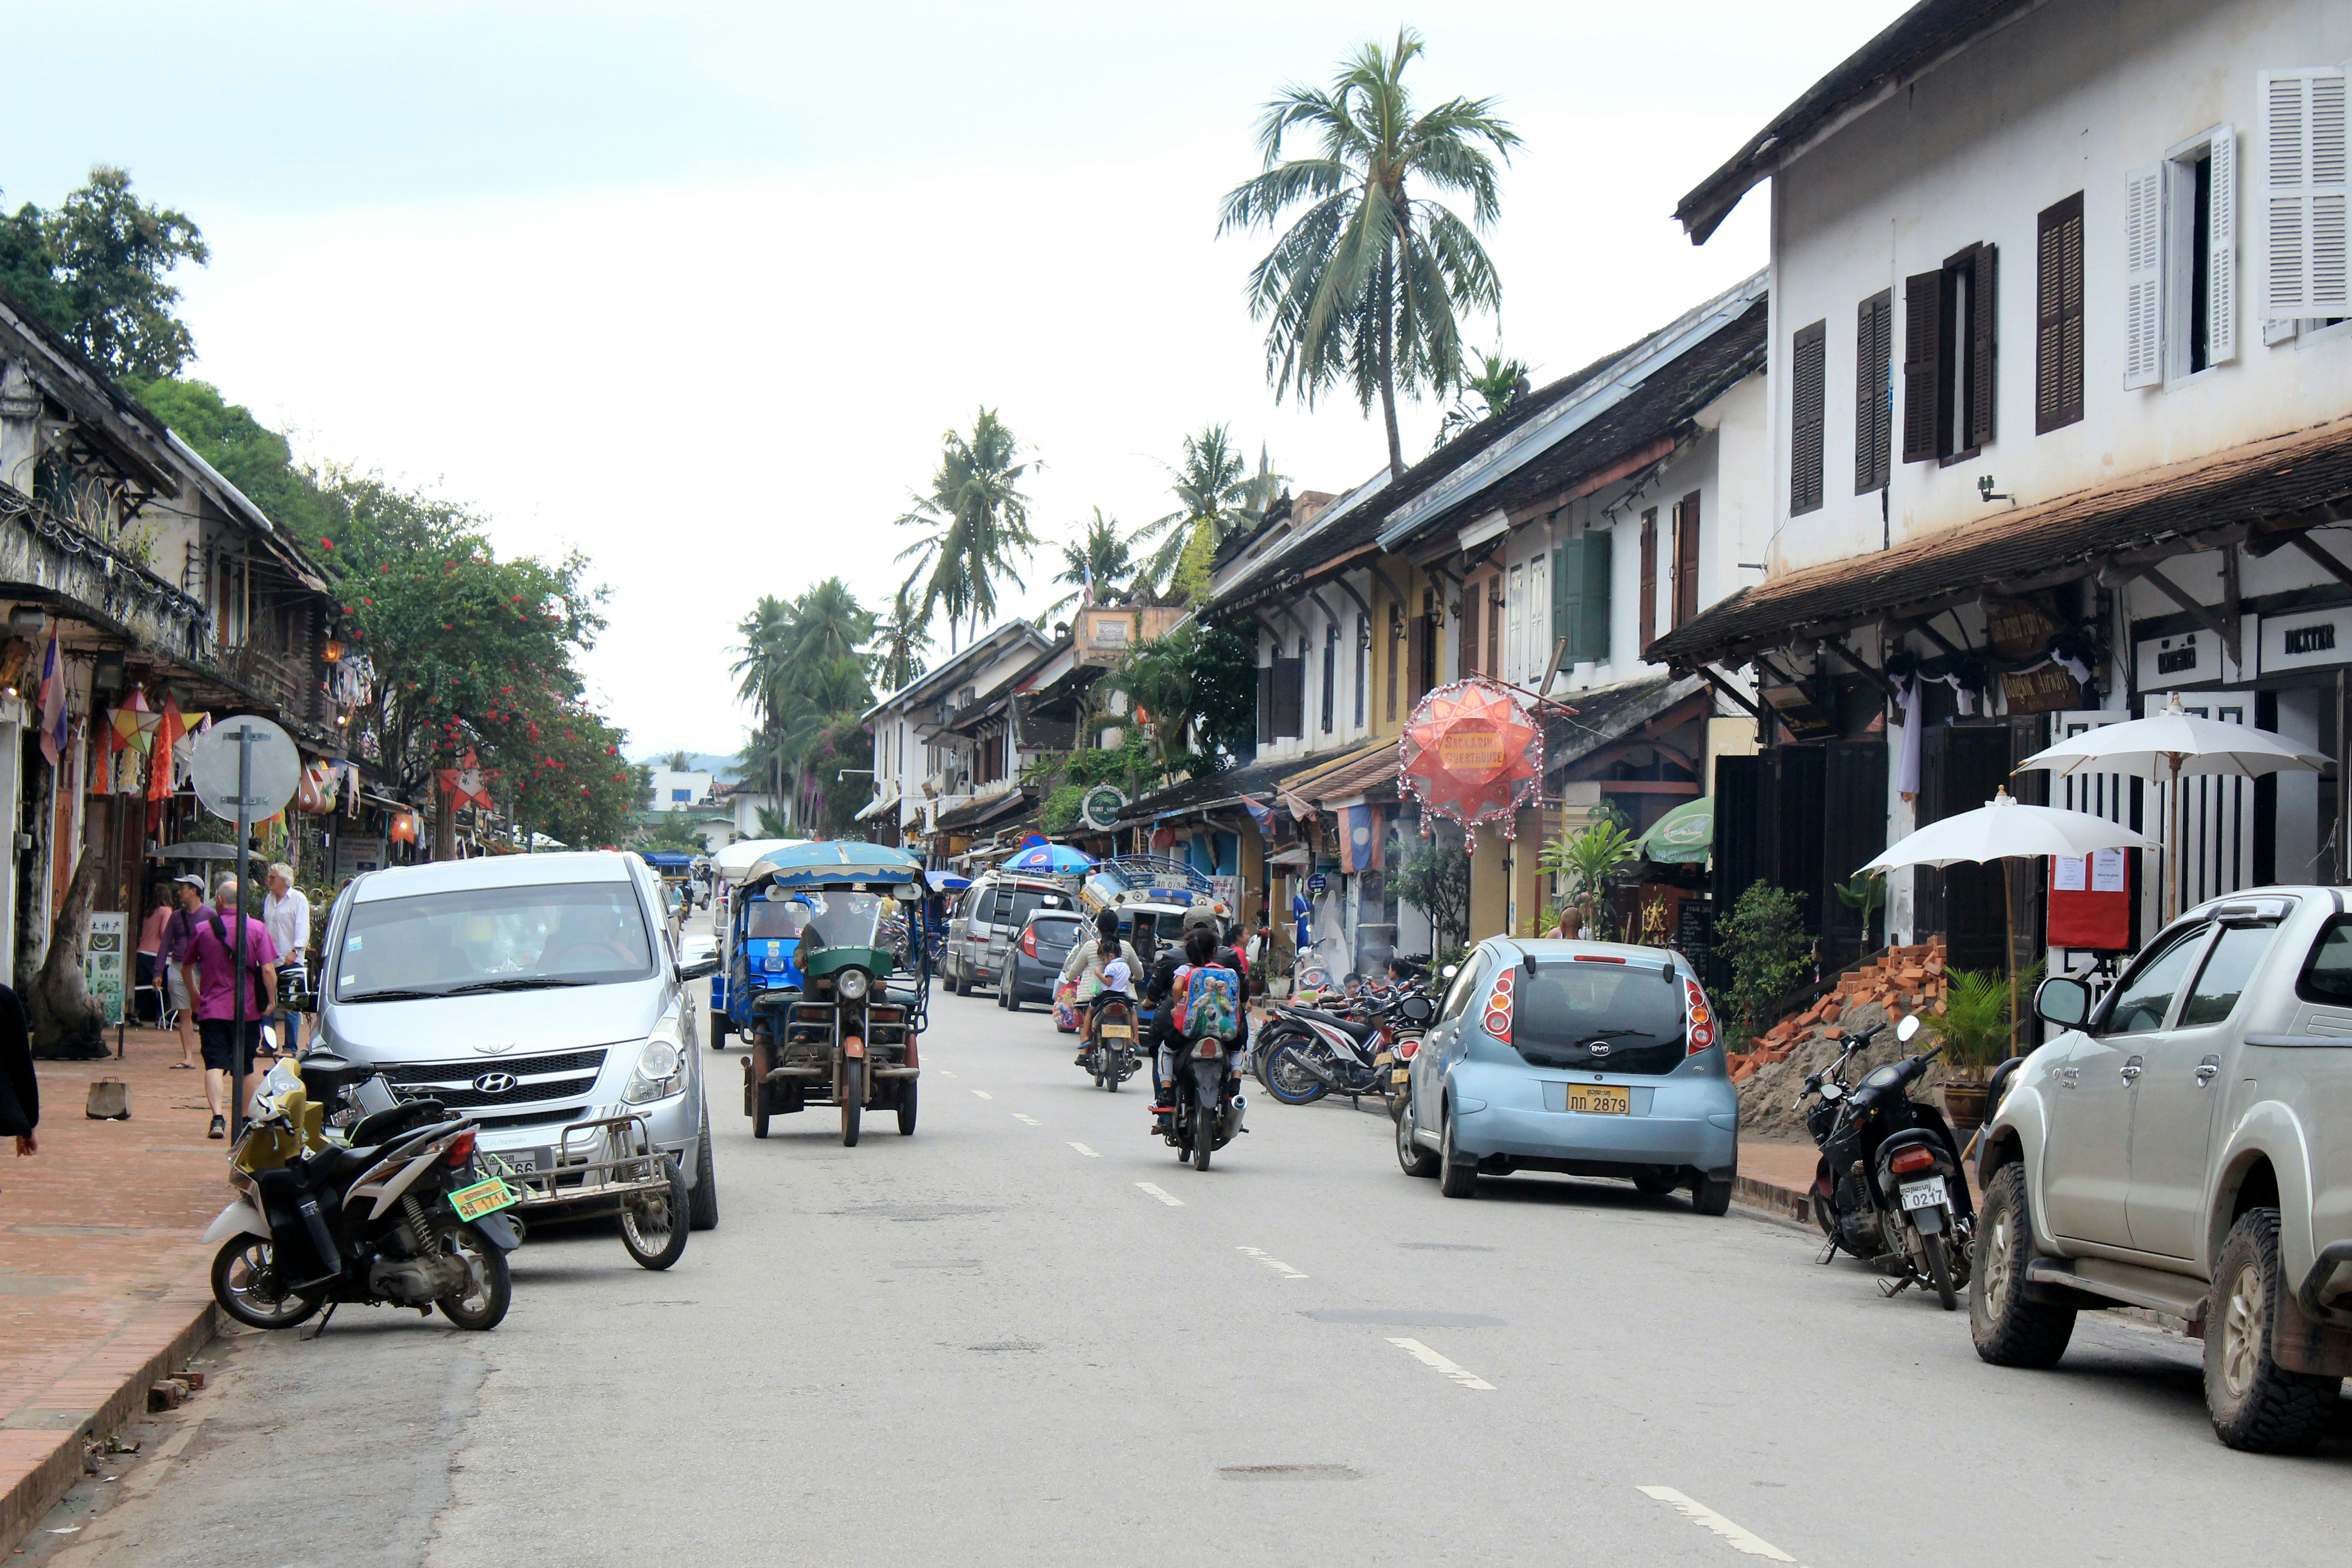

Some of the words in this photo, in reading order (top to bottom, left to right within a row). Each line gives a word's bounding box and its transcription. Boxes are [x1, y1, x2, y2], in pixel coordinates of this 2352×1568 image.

[2284, 624, 2335, 654] DEXTER
[2002, 672, 2035, 704] Bangkok
[2038, 668, 2069, 699] Airways
[1446, 751, 1502, 764] GUESTHOUSE
[1594, 1098, 1626, 1112] 2879
[481, 1191, 510, 1209] 1714
[1913, 1189, 1942, 1206] 0217
